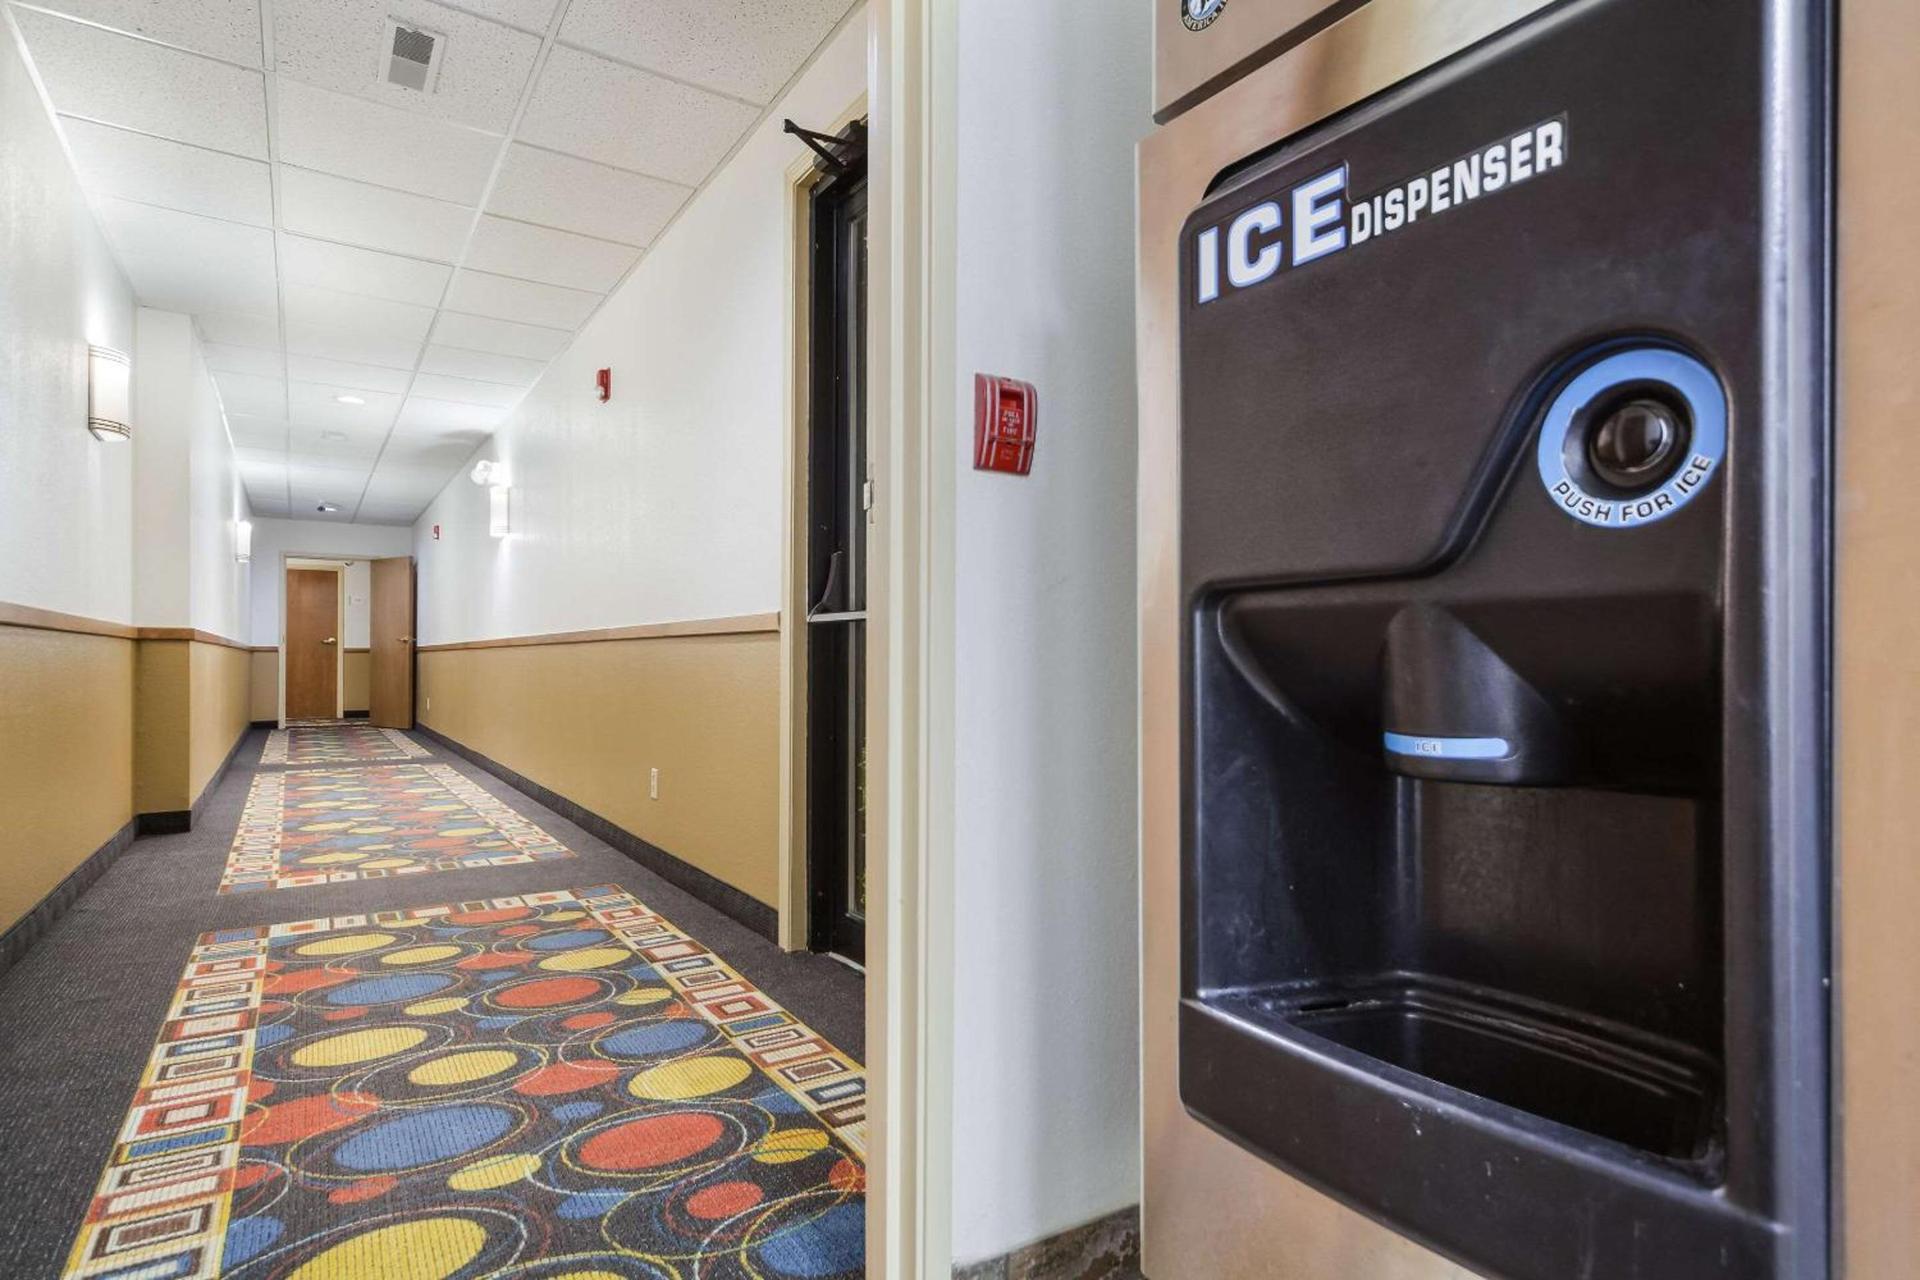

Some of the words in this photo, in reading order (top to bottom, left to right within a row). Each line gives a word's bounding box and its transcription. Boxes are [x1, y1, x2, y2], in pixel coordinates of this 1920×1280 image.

[1198, 166, 1347, 304] ICE
[1351, 120, 1564, 246] DISPENSER
[1553, 481, 1612, 521] PUSH
[1621, 492, 1674, 522] FOR
[1675, 456, 1712, 494] ICE
